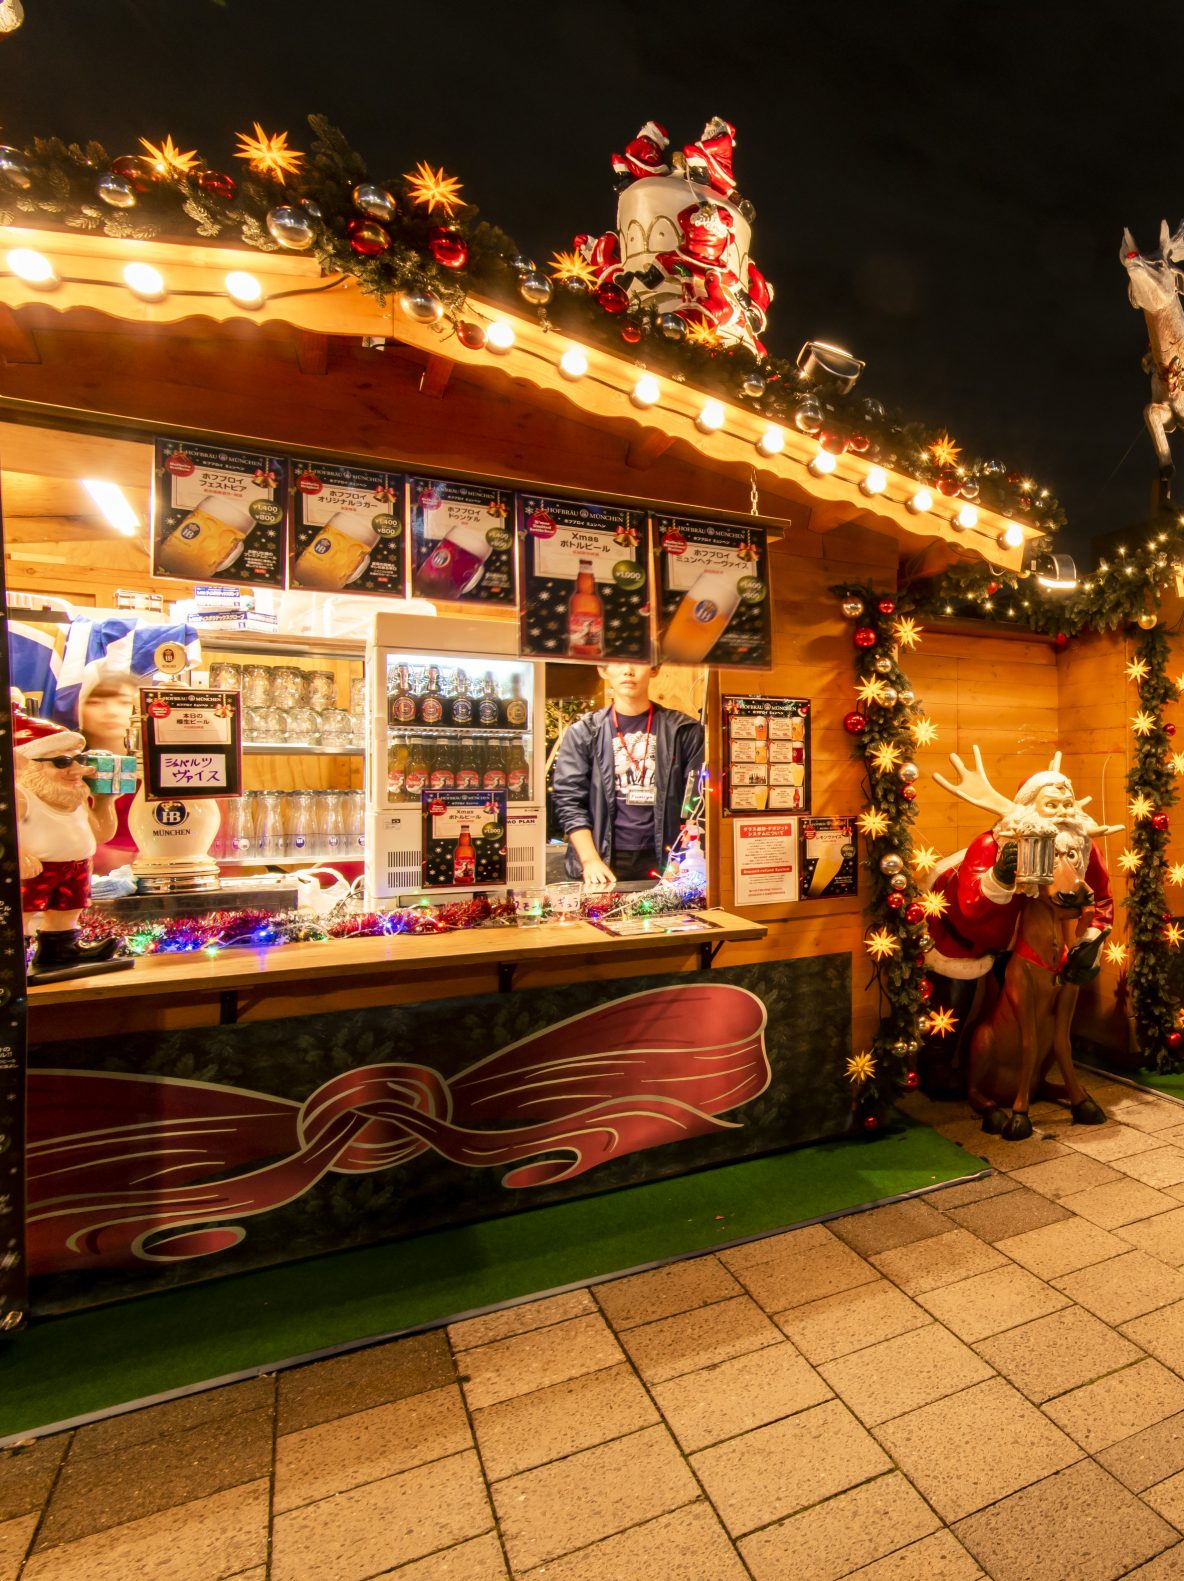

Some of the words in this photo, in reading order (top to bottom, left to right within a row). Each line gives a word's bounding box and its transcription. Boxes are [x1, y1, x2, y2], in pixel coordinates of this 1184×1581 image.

[185, 449, 218, 460] HOFBRÄU
[228, 456, 263, 467] MÜNCHEN
[202, 472, 245, 485] ホフブロイ
[352, 474, 383, 483] MÜNCHEN
[199, 480, 248, 492] フェストビア
[329, 490, 368, 501] ホフブロイ
[318, 496, 379, 509] オリジナルラガー
[447, 506, 481, 516] ホフブロイ
[547, 507, 579, 517] HOFBRÄU
[589, 512, 624, 523] MÜNCHEN
[255, 514, 276, 522] ¥800
[448, 513, 481, 523] ドゥンケル
[571, 532, 599, 543] Xmas
[678, 526, 706, 535] HOFBRÄU
[714, 530, 746, 539] MÜNCHEN
[560, 540, 611, 553] ボトルビール
[694, 549, 731, 559] ホフブロイ
[676, 556, 750, 570] ミュンヘナーヴァイス
[172, 769, 221, 784] ヴァイス
[162, 811, 181, 823] HB
[152, 828, 191, 837] MÜNCHEN
